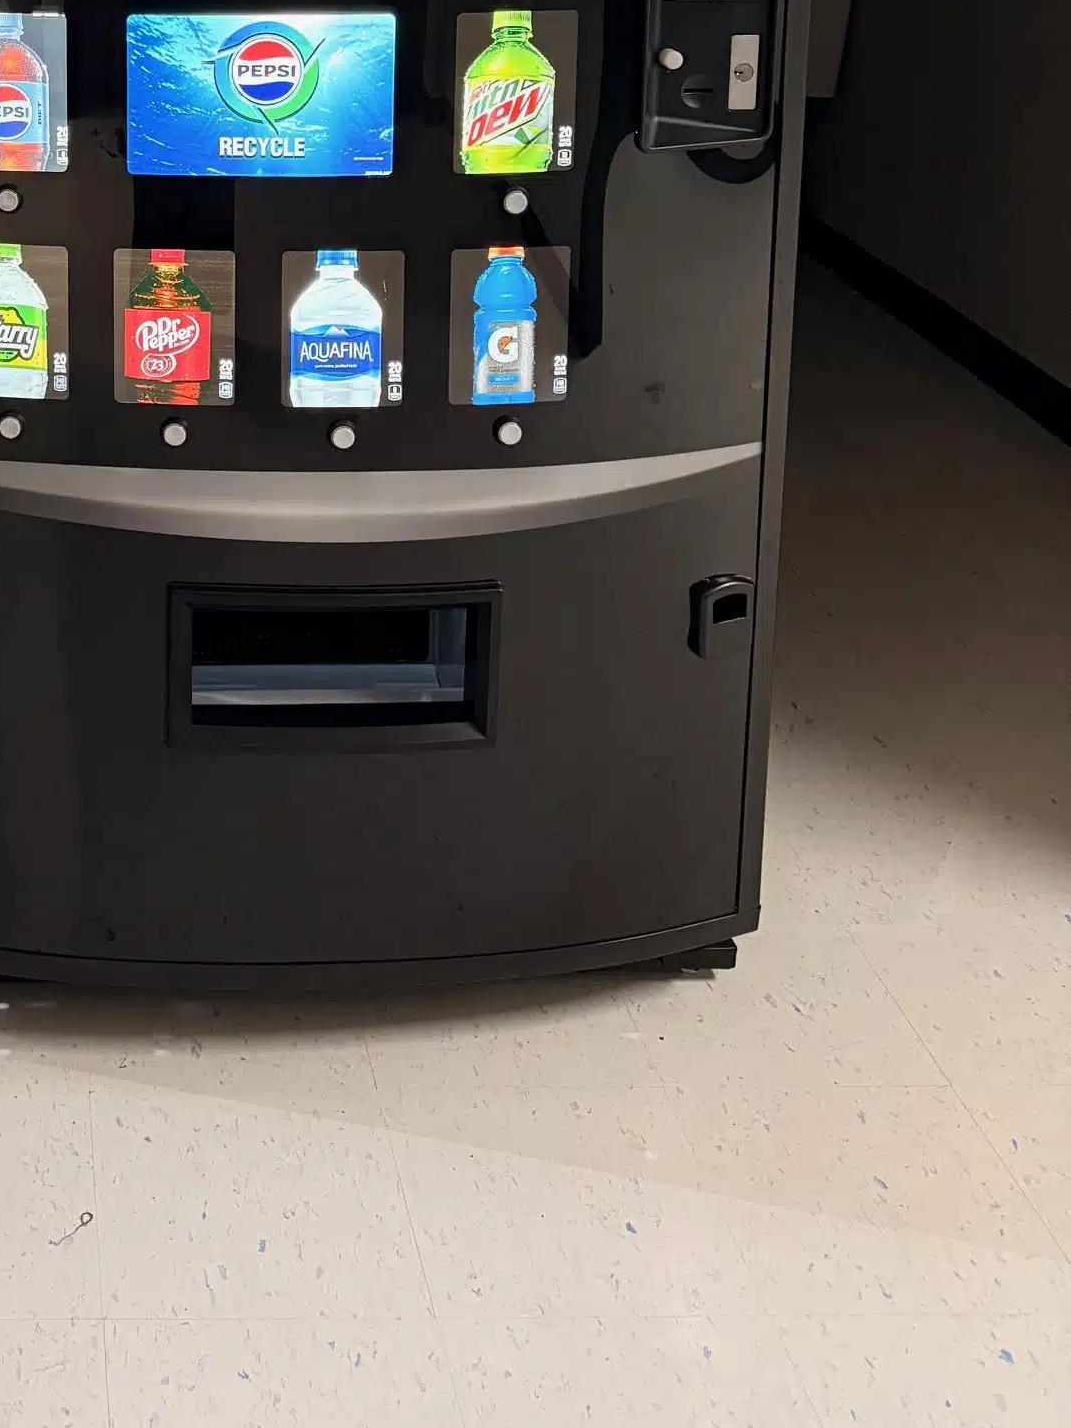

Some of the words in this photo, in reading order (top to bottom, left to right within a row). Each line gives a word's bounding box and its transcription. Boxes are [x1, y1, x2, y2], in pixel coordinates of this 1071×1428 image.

[237, 64, 296, 78] PEPSI
[558, 126, 572, 137] 20
[218, 136, 306, 159] RECYCLE
[157, 316, 181, 334] Dr
[142, 324, 195, 350] Pepper
[488, 326, 518, 363] G
[300, 340, 372, 363] AQUAFINA
[53, 353, 67, 364] 20
[150, 359, 165, 370] 23
[554, 355, 567, 367] 20
[219, 360, 233, 371] 20
[388, 362, 402, 373] 20
